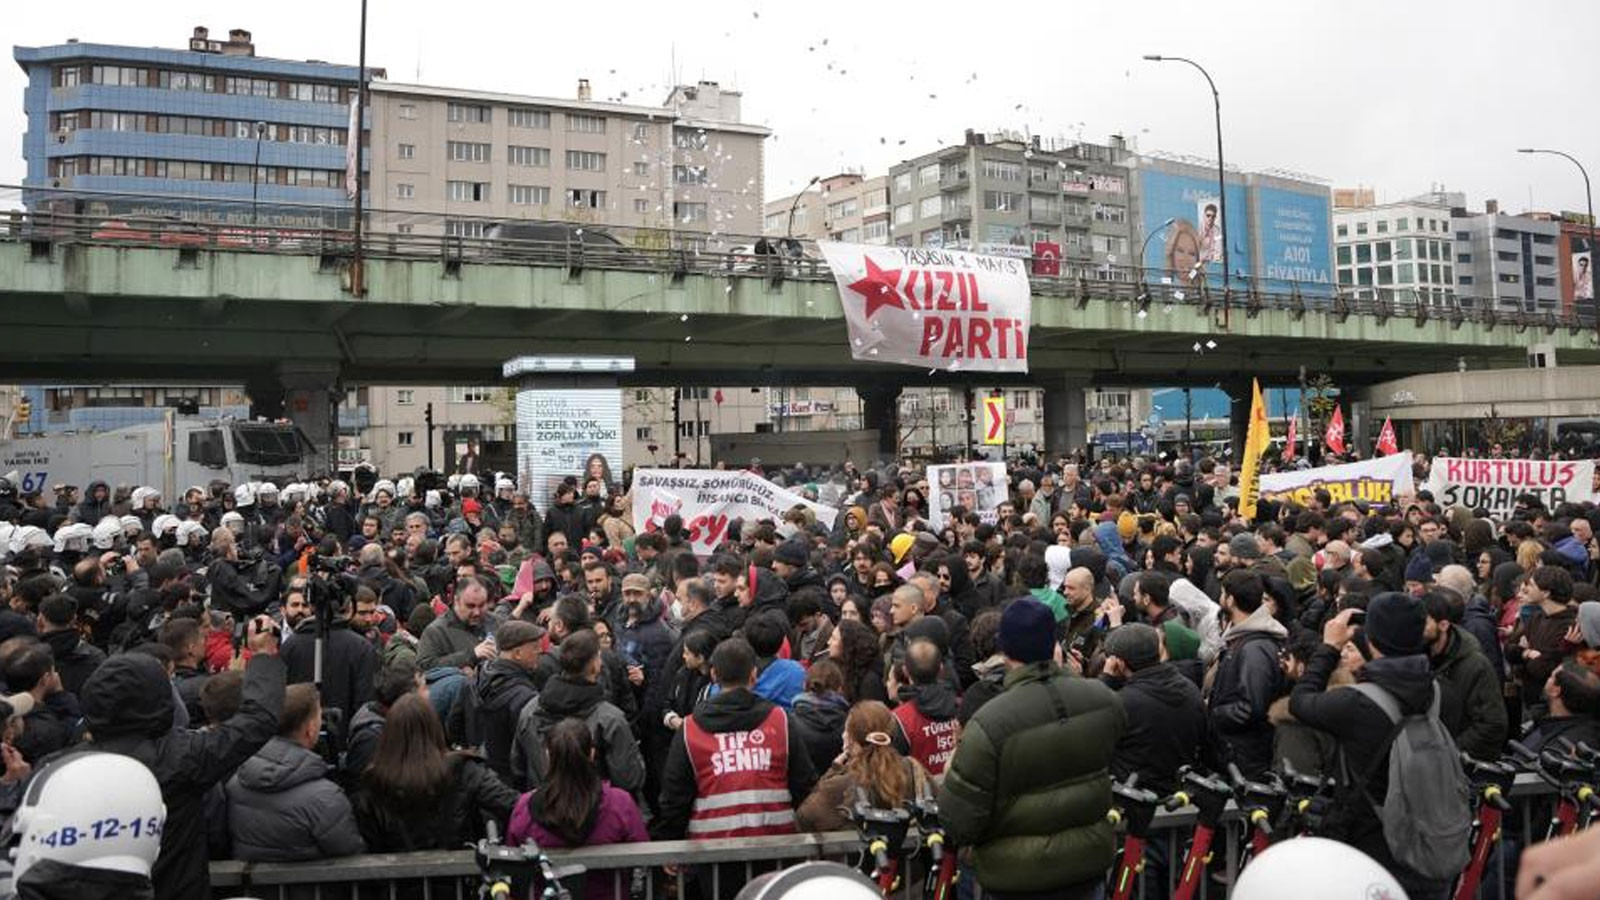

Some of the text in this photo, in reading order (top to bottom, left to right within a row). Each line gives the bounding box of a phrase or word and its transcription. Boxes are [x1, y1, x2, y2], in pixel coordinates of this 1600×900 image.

[918, 316, 1025, 359] PARTİ
[536, 418, 571, 430] KEFİL
[536, 431, 585, 441] ZORLUK
[22, 471, 48, 493] 67
[713, 731, 749, 751] TİP
[710, 747, 772, 776] SENİN
